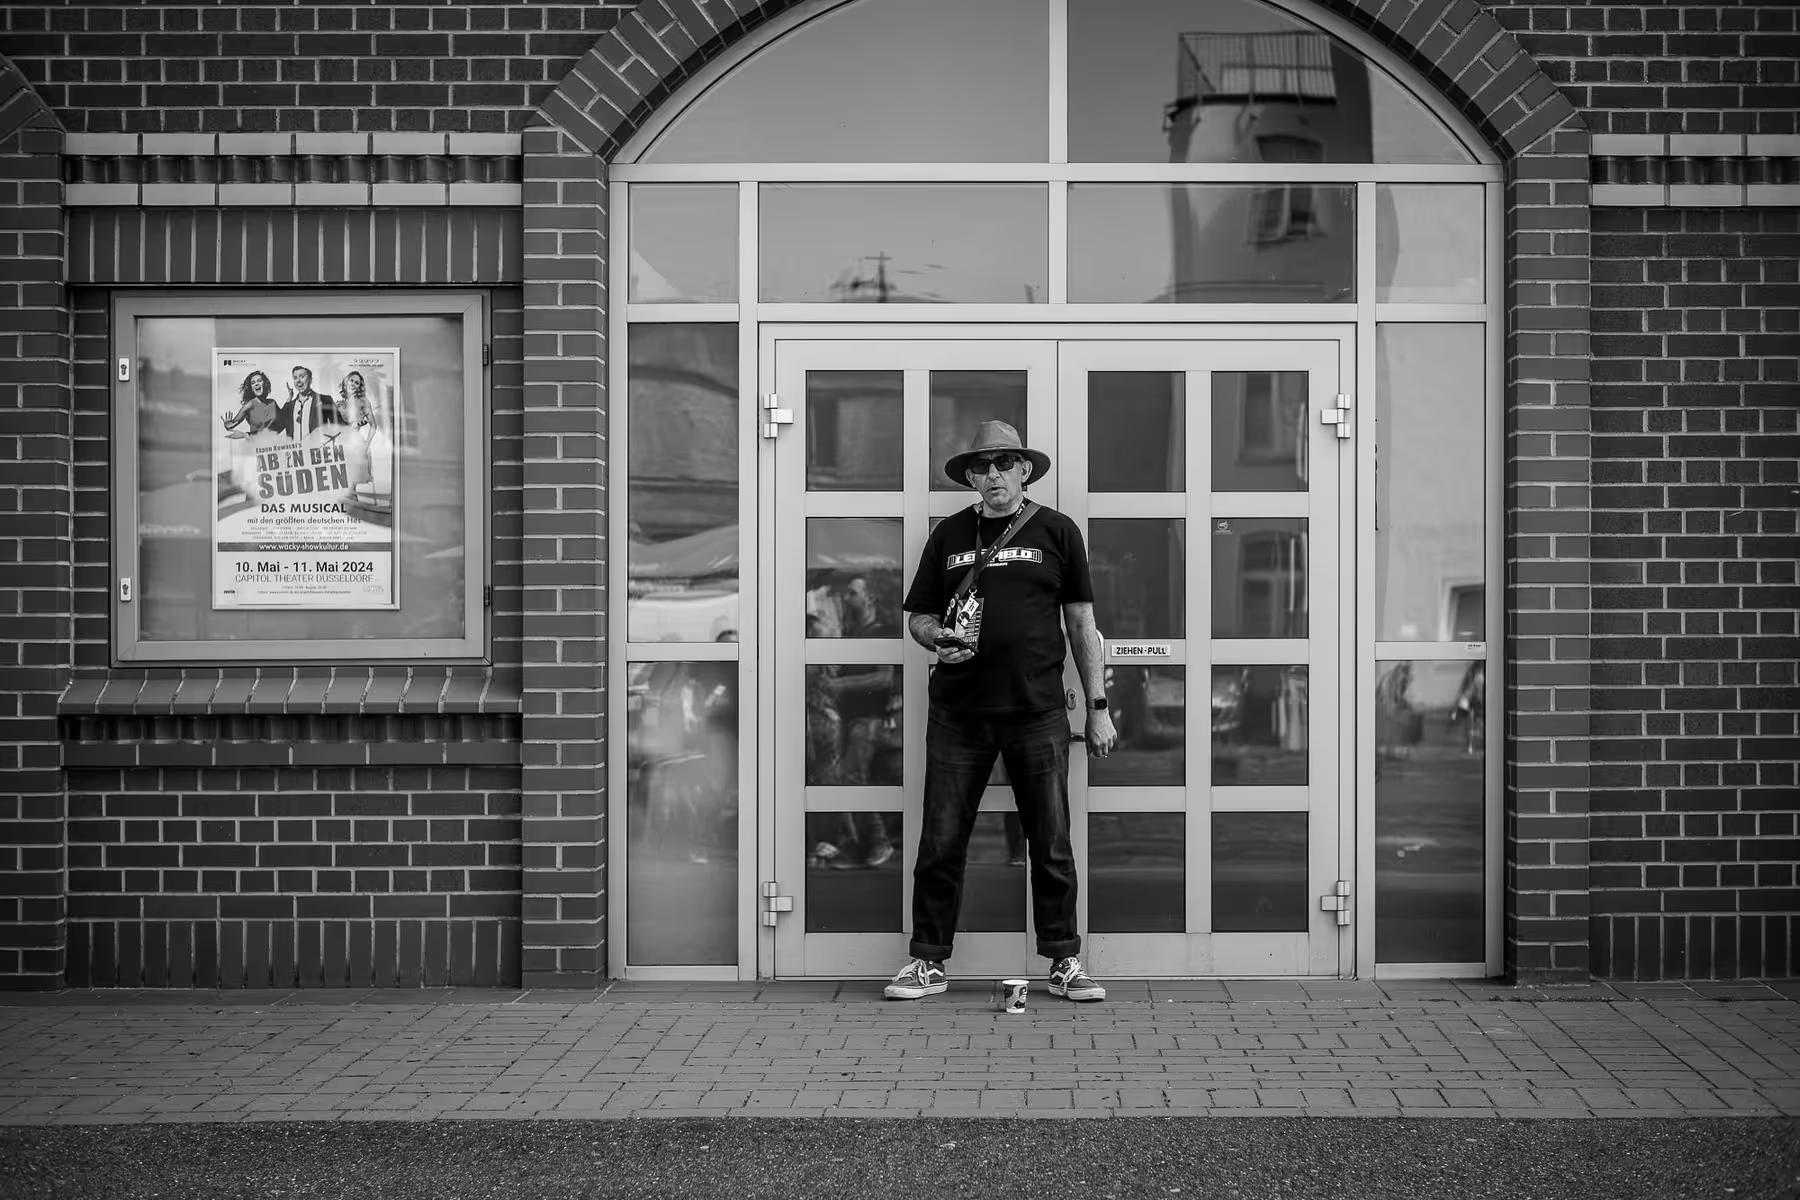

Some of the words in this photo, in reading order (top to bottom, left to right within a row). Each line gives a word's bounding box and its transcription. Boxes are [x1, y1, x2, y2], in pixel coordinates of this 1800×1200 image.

[256, 453, 280, 473] AB
[309, 444, 346, 466] DEN
[258, 463, 349, 500] SÜDEN
[261, 503, 286, 513] DAS
[290, 503, 347, 513] MUSICAL
[247, 516, 258, 524] mit
[260, 516, 274, 524] den
[275, 516, 305, 525] größten
[307, 516, 345, 524] deutschen
[346, 516, 361, 524] Hits
[258, 542, 349, 551] www.wacky-showkultur.de
[235, 561, 254, 573] 10.
[257, 561, 280, 573] Mai
[292, 561, 312, 573] 11.
[316, 561, 339, 573] Mai
[342, 561, 374, 573] 2024
[235, 574, 272, 583] CAPITOL
[275, 574, 314, 583] THEATER
[315, 572, 374, 583] DÜSSELDORF
[1116, 646, 1143, 655] ZIEHEN
[1147, 646, 1167, 655] PULL
